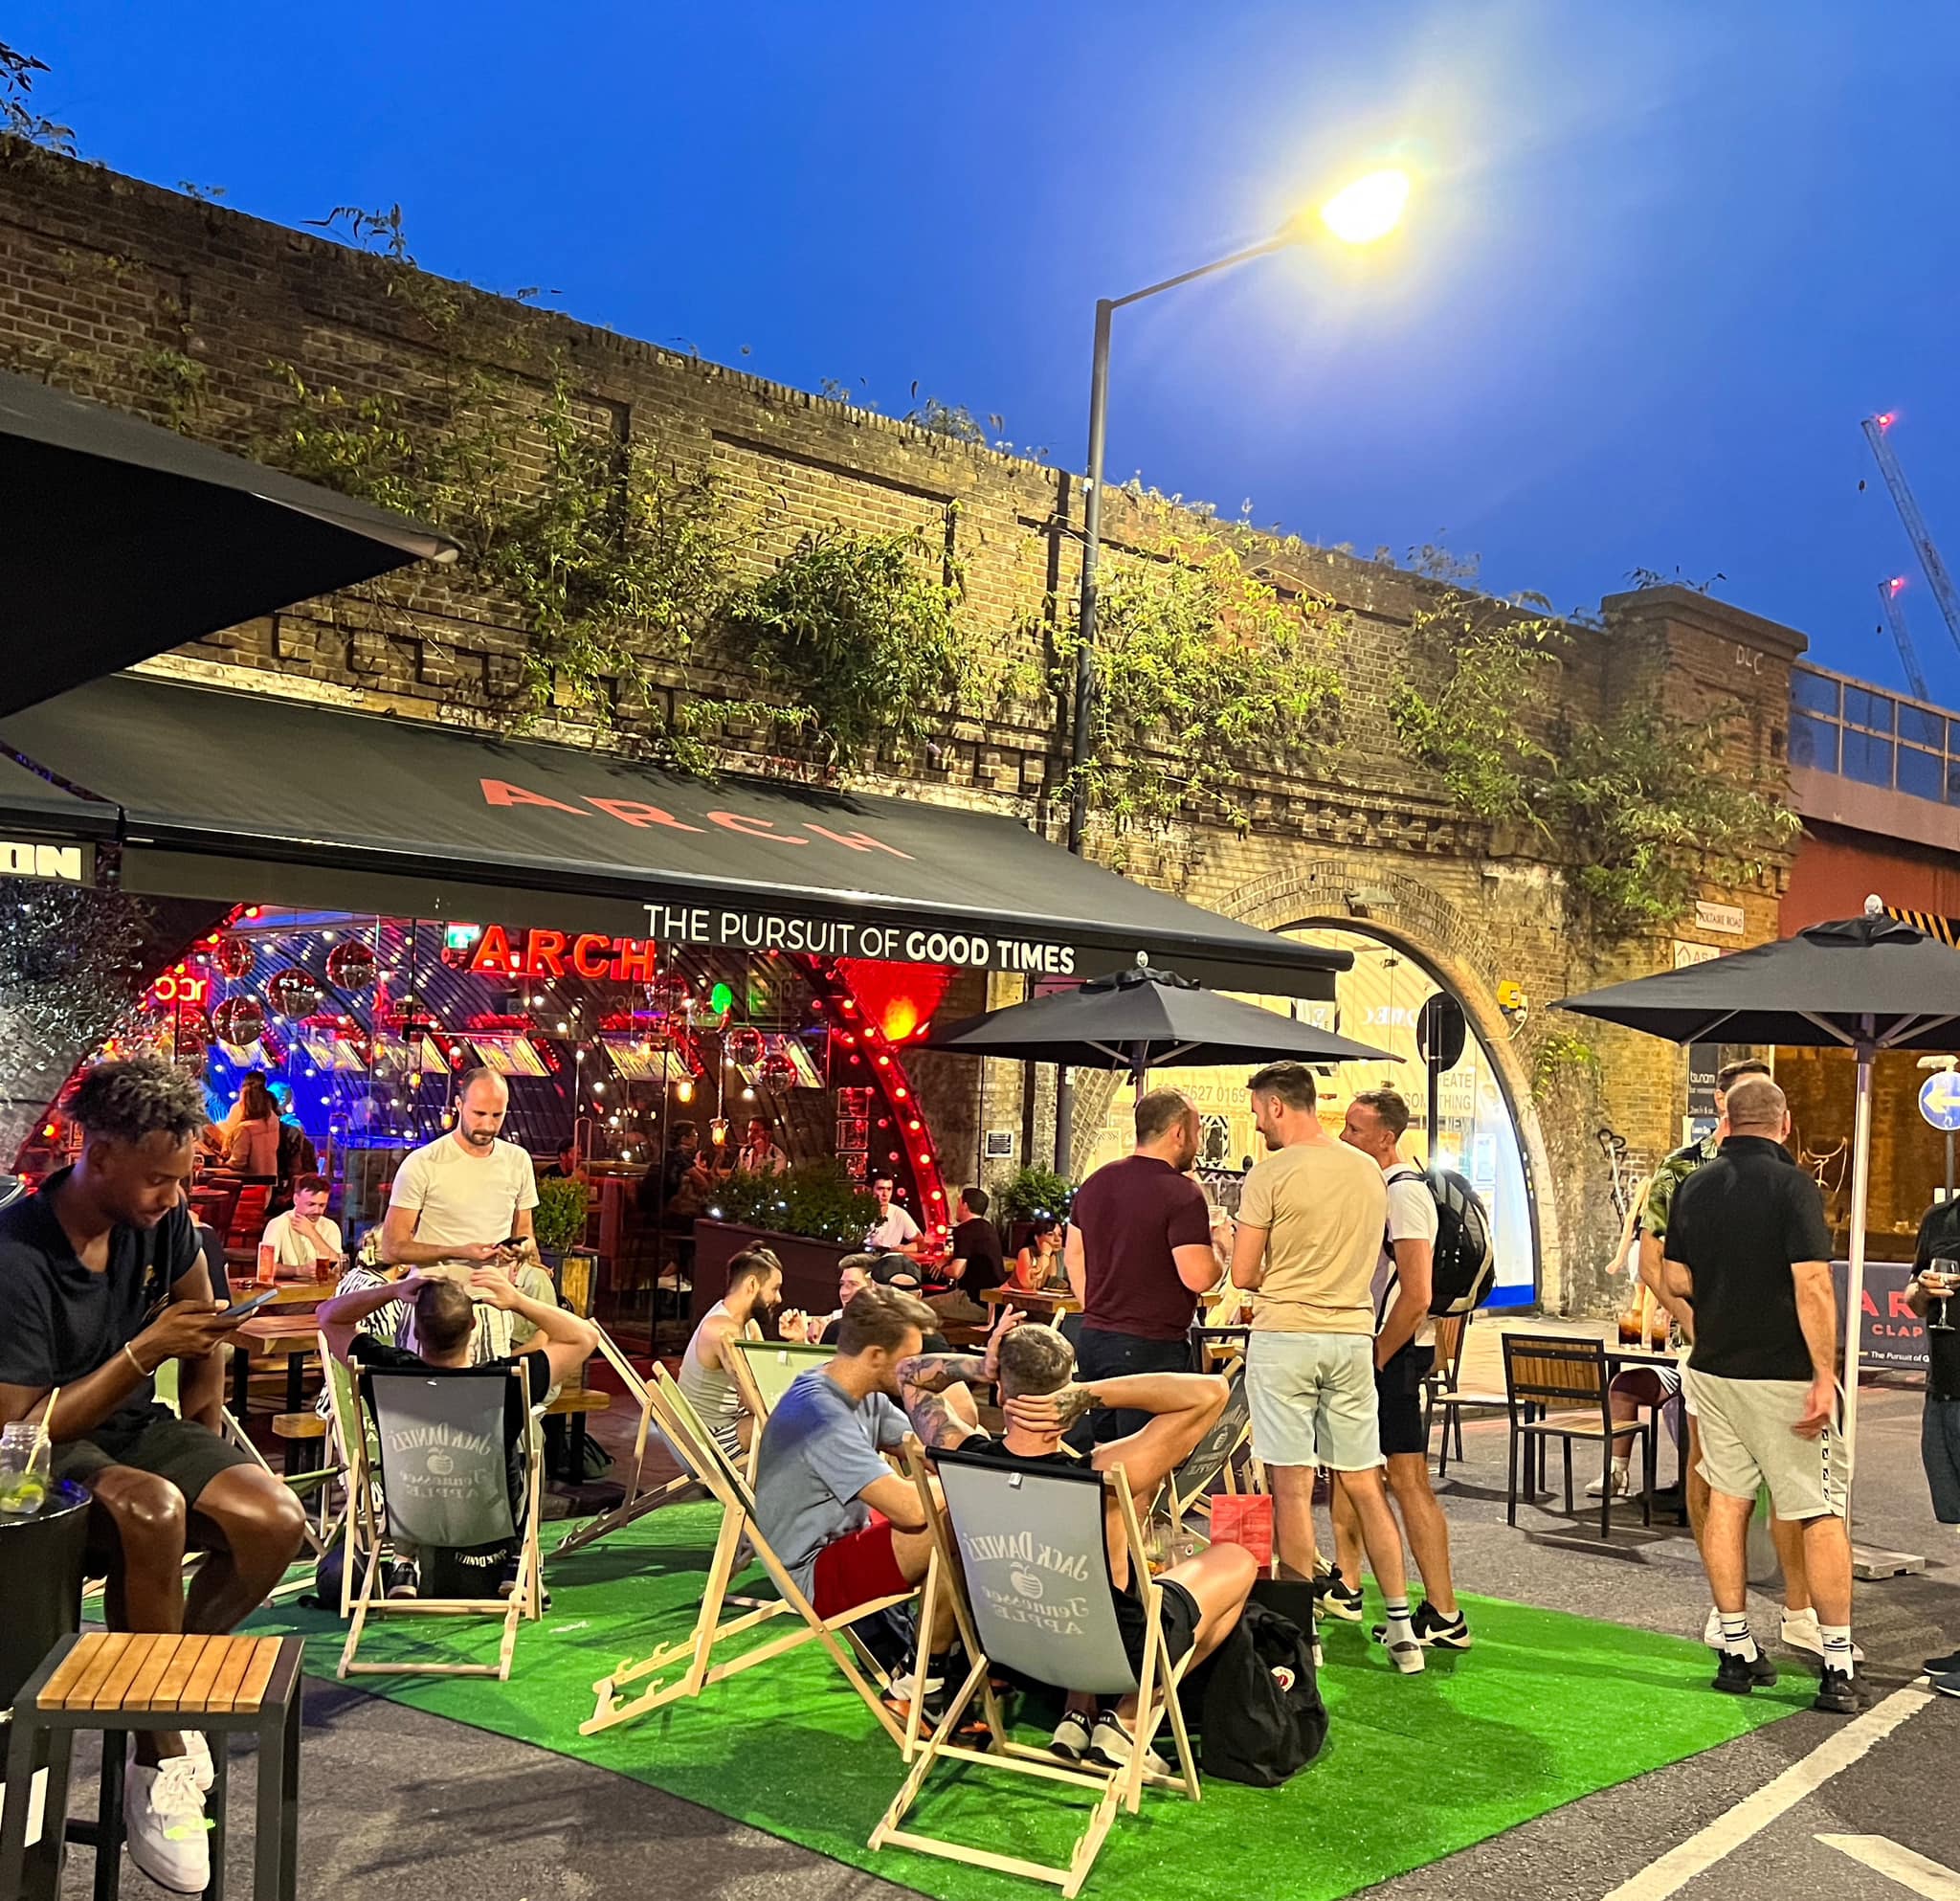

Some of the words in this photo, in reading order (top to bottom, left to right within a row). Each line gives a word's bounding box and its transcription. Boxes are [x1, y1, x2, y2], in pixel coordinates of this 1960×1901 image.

[479, 778, 916, 860] ARCH
[643, 905, 710, 942] THE
[721, 912, 856, 954] PURSUIT
[859, 927, 901, 958] OF
[905, 930, 990, 967] GOOD
[996, 940, 1076, 974] TIMES
[470, 924, 657, 982] ARCH
[1438, 1073, 1472, 1088] EATE
[1216, 1086, 1246, 1104] 0169
[1861, 1288, 1919, 1319] AR
[1872, 1324, 1923, 1337] CLAP
[1871, 1351, 1885, 1359] The
[1886, 1352, 1912, 1362] Pursuit
